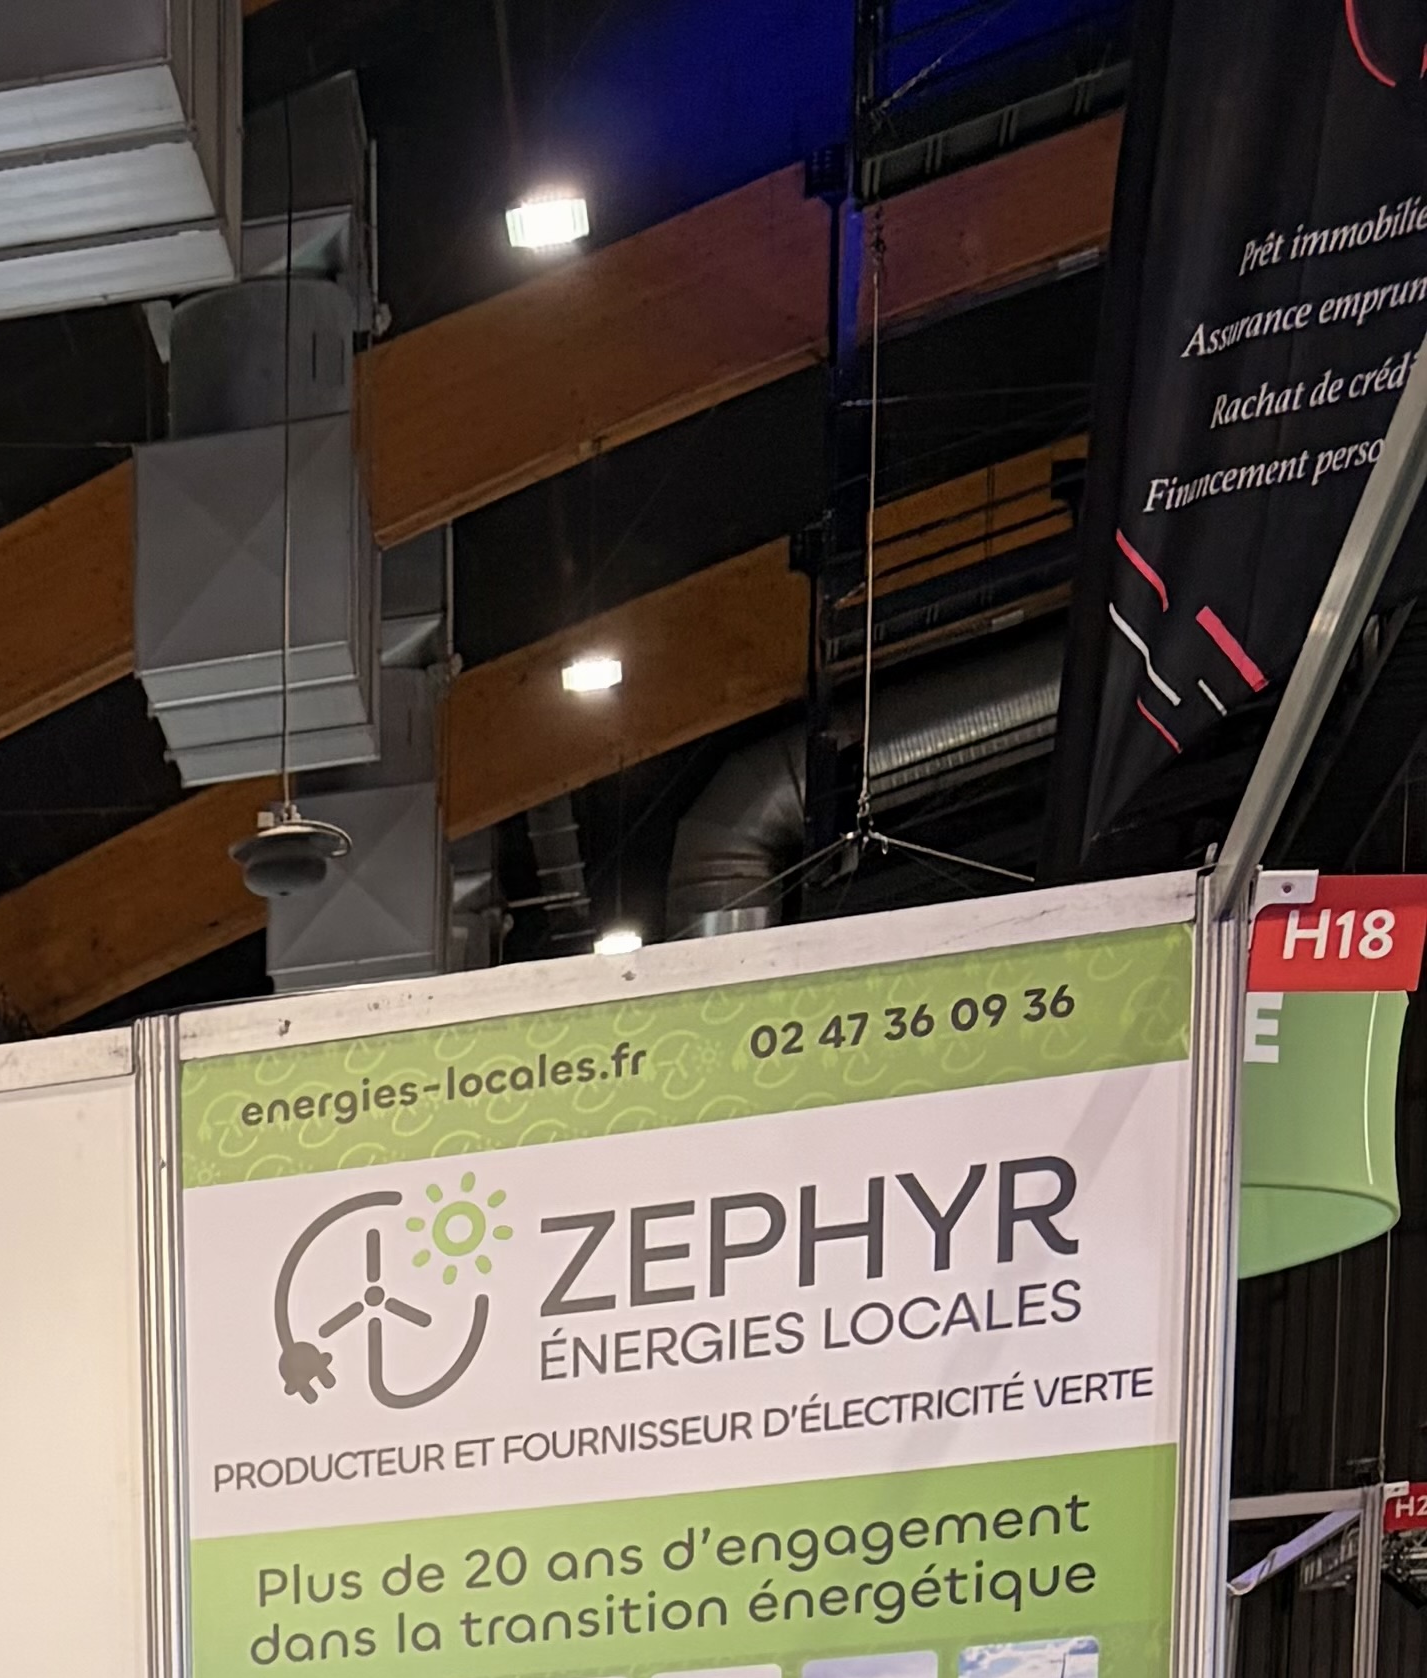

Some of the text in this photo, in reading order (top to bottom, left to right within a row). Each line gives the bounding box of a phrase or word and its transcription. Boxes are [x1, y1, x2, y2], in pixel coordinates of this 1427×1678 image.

[1239, 195, 1427, 276] Prêt immobilie
[1180, 276, 1427, 358] Assurance emprun
[1210, 382, 1305, 430] Rachat
[1309, 369, 1344, 408] de
[1143, 437, 1386, 513] Financement perso
[1282, 908, 1396, 960] H18
[750, 984, 1075, 1059] 02 47 36 09 36
[241, 1041, 647, 1126] energies-locales.fr
[540, 1155, 1079, 1317] ZEPHYR
[541, 1279, 1082, 1381] ÉNERGIES LOCALES
[214, 1366, 1154, 1493] PRODUCTEUR ET FOURNISSEUR D'ÉLECTRICITÉ VERTE
[259, 1494, 1090, 1608] Plus de 20 ans d'engagement
[250, 1562, 1096, 1665] dans la transition énergétique
